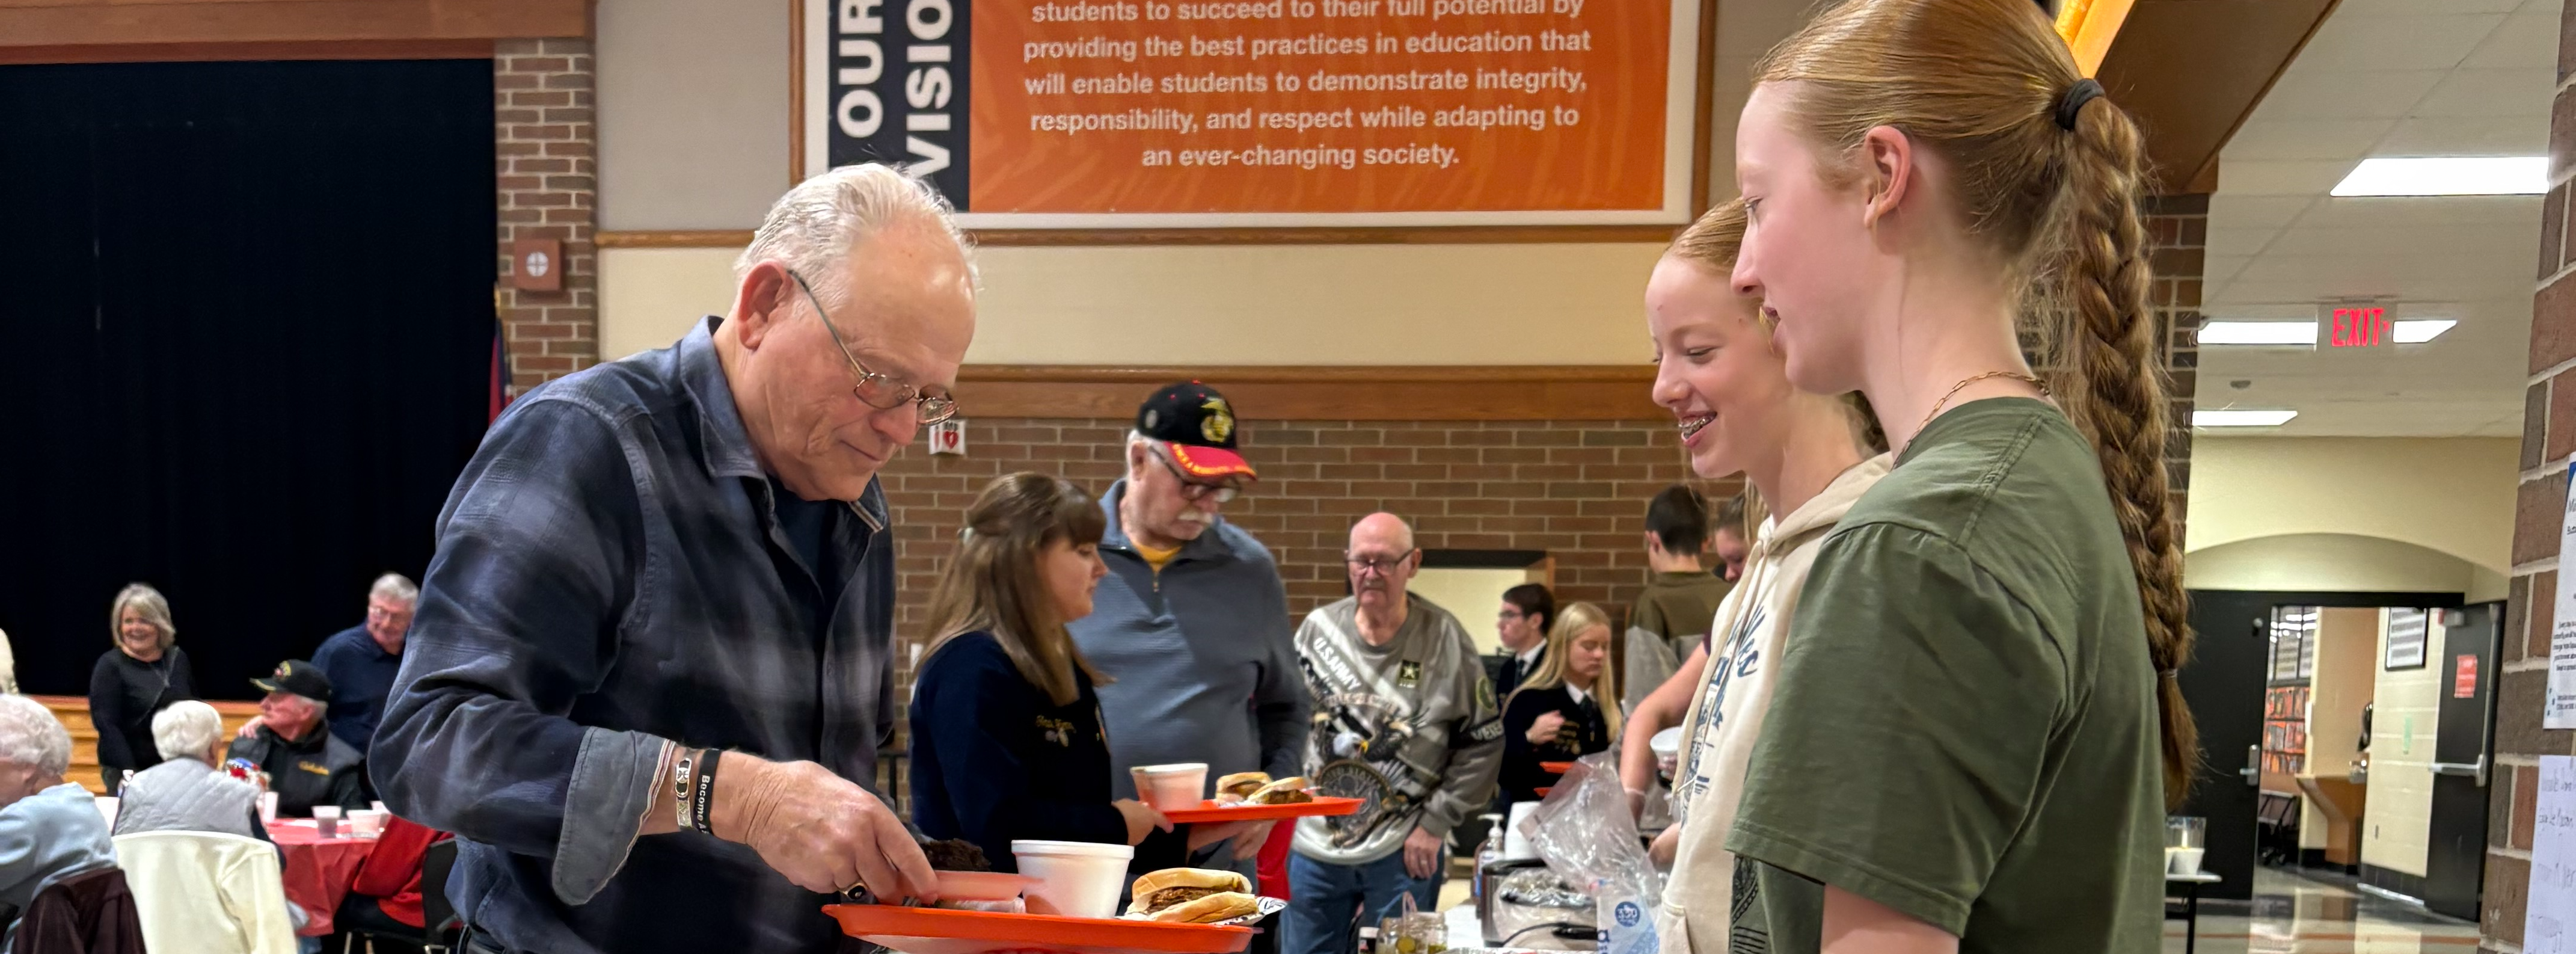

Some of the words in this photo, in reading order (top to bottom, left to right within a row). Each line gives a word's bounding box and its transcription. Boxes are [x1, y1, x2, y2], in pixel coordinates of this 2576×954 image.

[1032, 0, 1138, 23] students
[1146, 1, 1171, 20] to
[1177, 0, 1283, 20] succeed
[1290, 0, 1314, 18] to
[1322, 0, 1380, 17] their
[1388, 0, 1425, 16] full
[1434, 0, 1545, 20] potential
[1553, 0, 1584, 18] by
[1023, 36, 1137, 63] providing
[1144, 35, 1184, 57] the
[1191, 35, 1244, 57] best
[1251, 33, 1368, 60] practices
[1376, 32, 1397, 53] in
[1405, 31, 1532, 54] education
[1541, 29, 1590, 51] that
[838, 0, 883, 138] OUR
[1024, 73, 1066, 95] will
[1072, 72, 1153, 94] enable
[1161, 72, 1268, 93] students
[1275, 72, 1301, 92] to
[1307, 69, 1468, 91] demonstrate
[1476, 67, 1586, 94] integrity,
[1031, 108, 1198, 136] responsibility,
[1206, 108, 1251, 129] and
[1259, 107, 1353, 133] respect
[1360, 106, 1426, 128] while
[1434, 104, 1545, 131] adapting
[1553, 105, 1578, 126] to
[1142, 150, 1172, 167] an
[1179, 144, 1356, 170] ever-changing
[1363, 143, 1459, 169] society.
[2332, 307, 2384, 346] EXIT
[697, 775, 711, 821] Become
